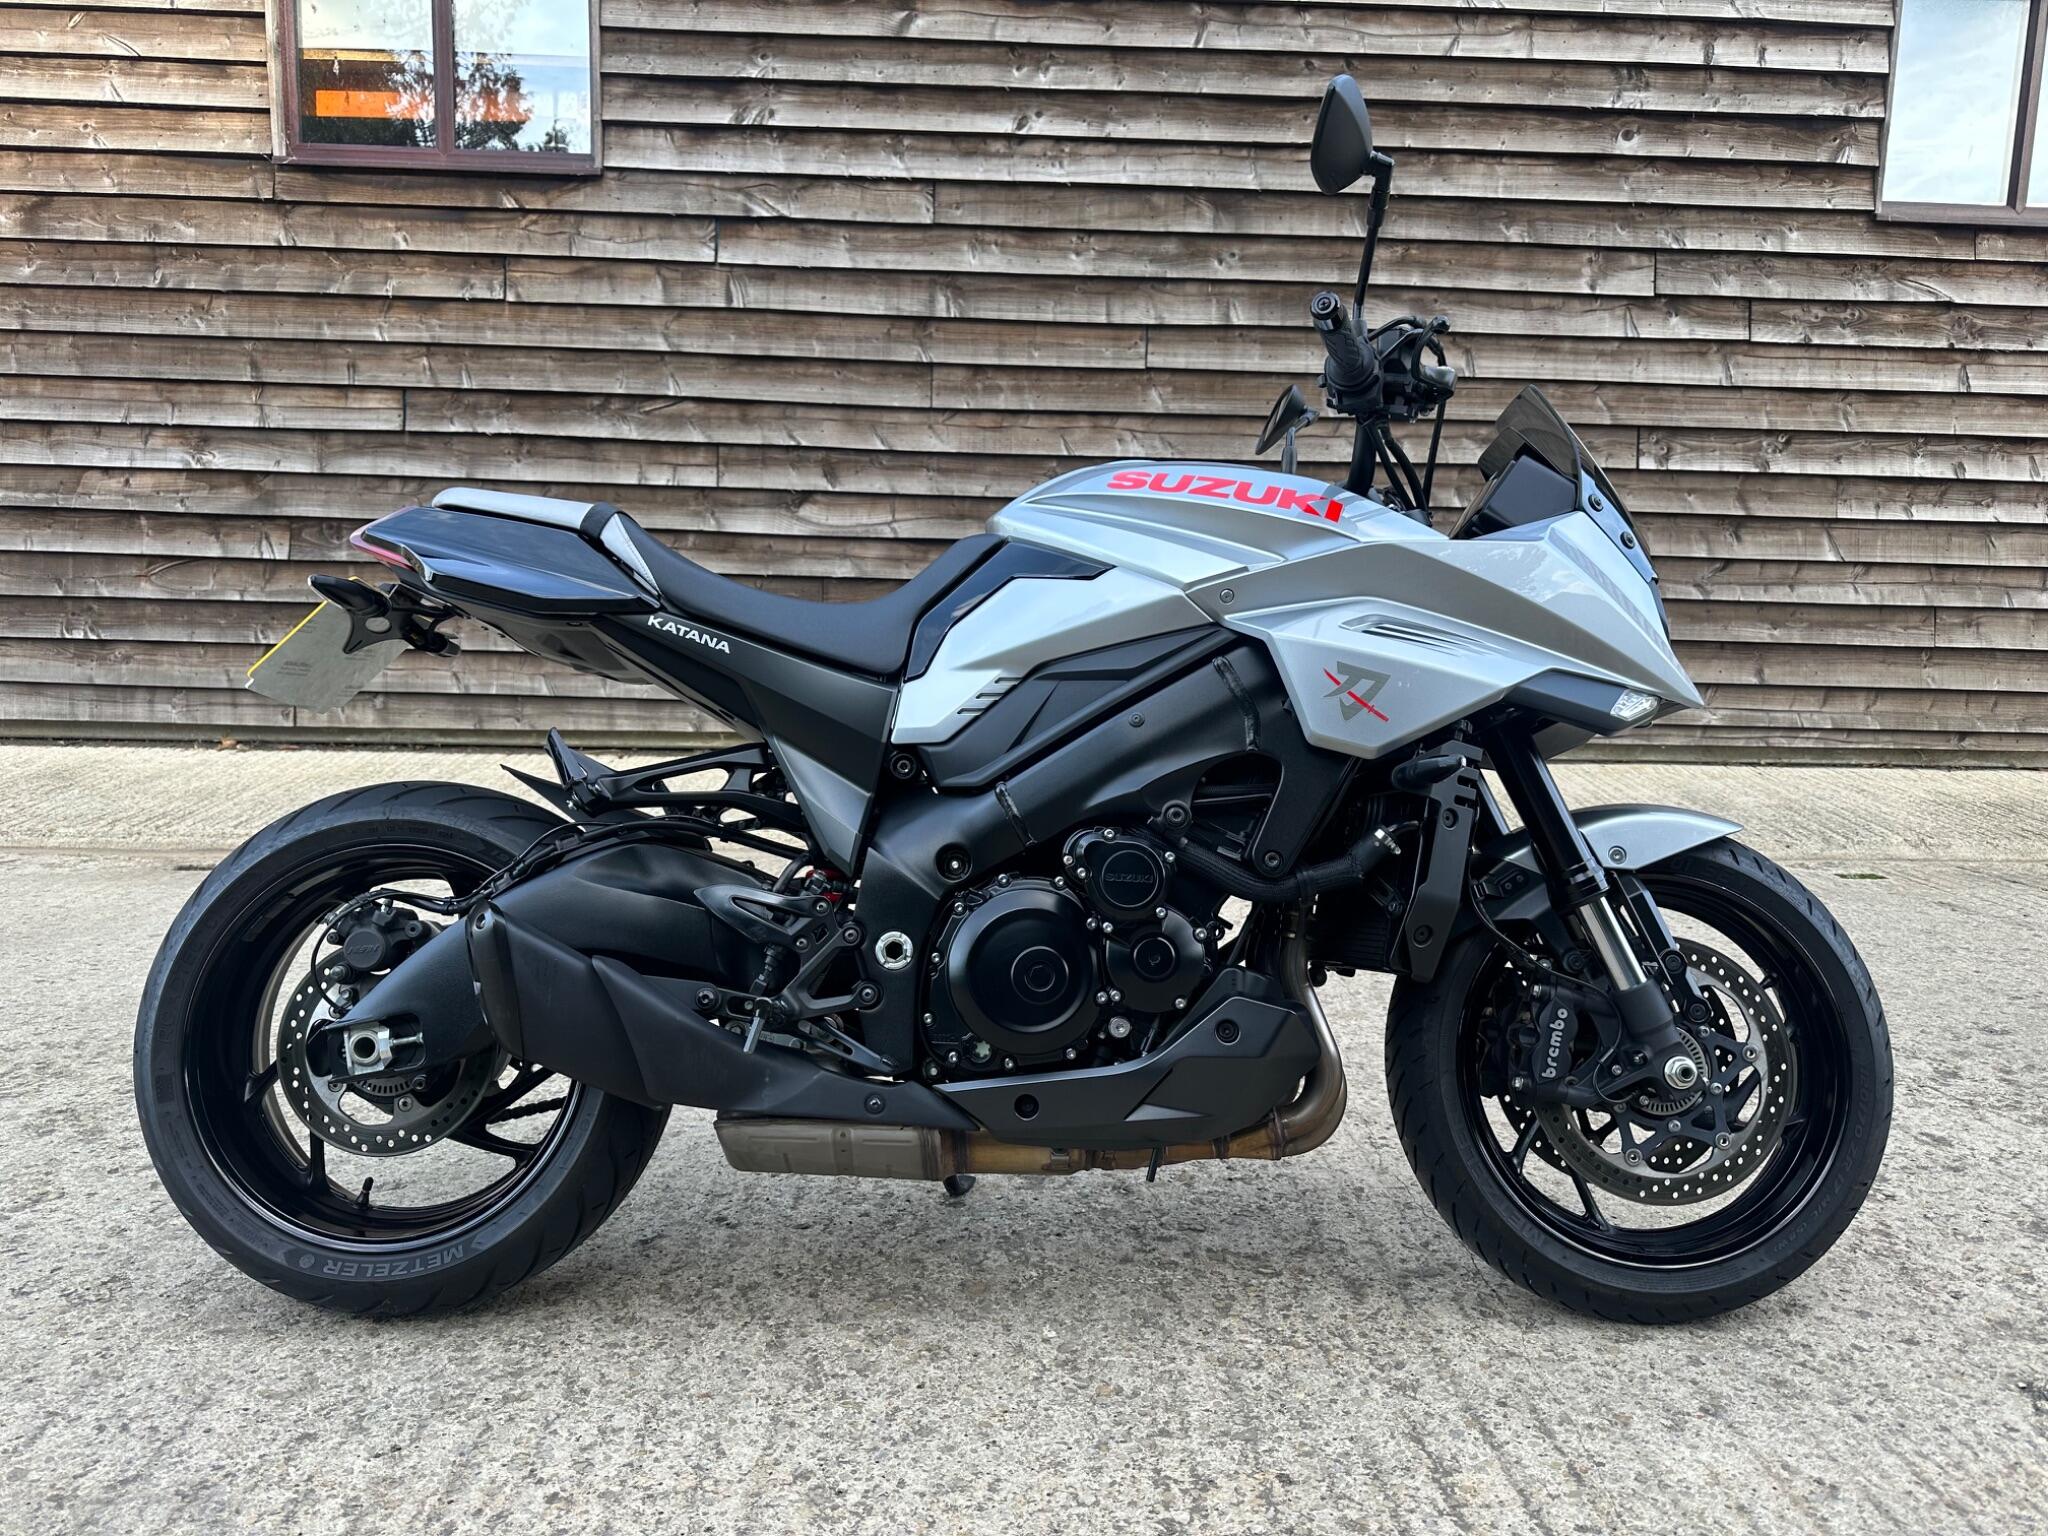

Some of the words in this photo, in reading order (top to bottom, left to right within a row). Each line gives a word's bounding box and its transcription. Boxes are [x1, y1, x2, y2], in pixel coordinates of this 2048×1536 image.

[1107, 471, 1344, 523] SUZUKI
[647, 615, 730, 654] KATANA
[1542, 1008, 1568, 1078] brembo
[323, 1244, 464, 1278] METZELER
